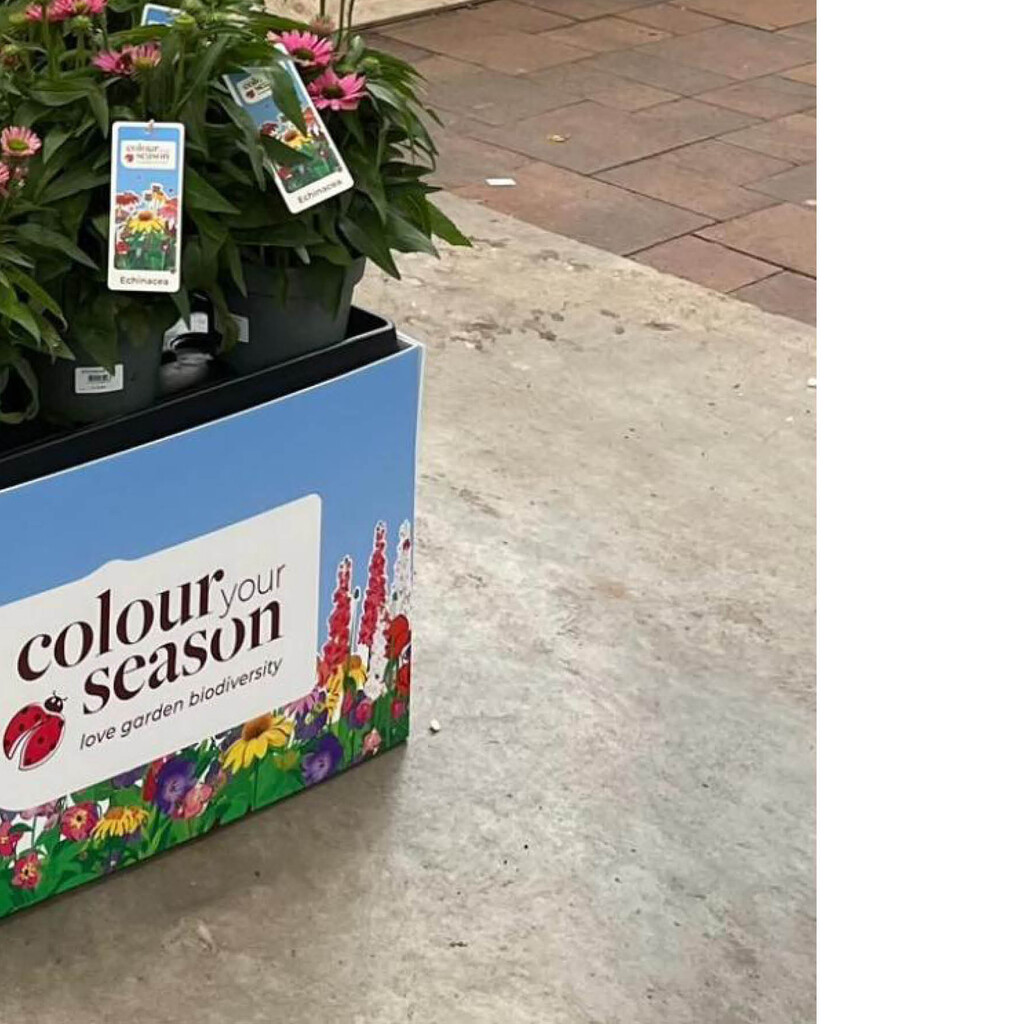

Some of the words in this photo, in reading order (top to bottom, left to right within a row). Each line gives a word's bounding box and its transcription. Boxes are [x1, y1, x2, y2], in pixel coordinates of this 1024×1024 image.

[297, 178, 343, 205] Echinacea
[120, 276, 170, 287] Echinacea
[17, 569, 225, 682] colour
[218, 564, 286, 619] your
[83, 600, 284, 715] season
[79, 725, 116, 751] love
[121, 700, 184, 737] garden
[188, 658, 283, 708] biodiversity
